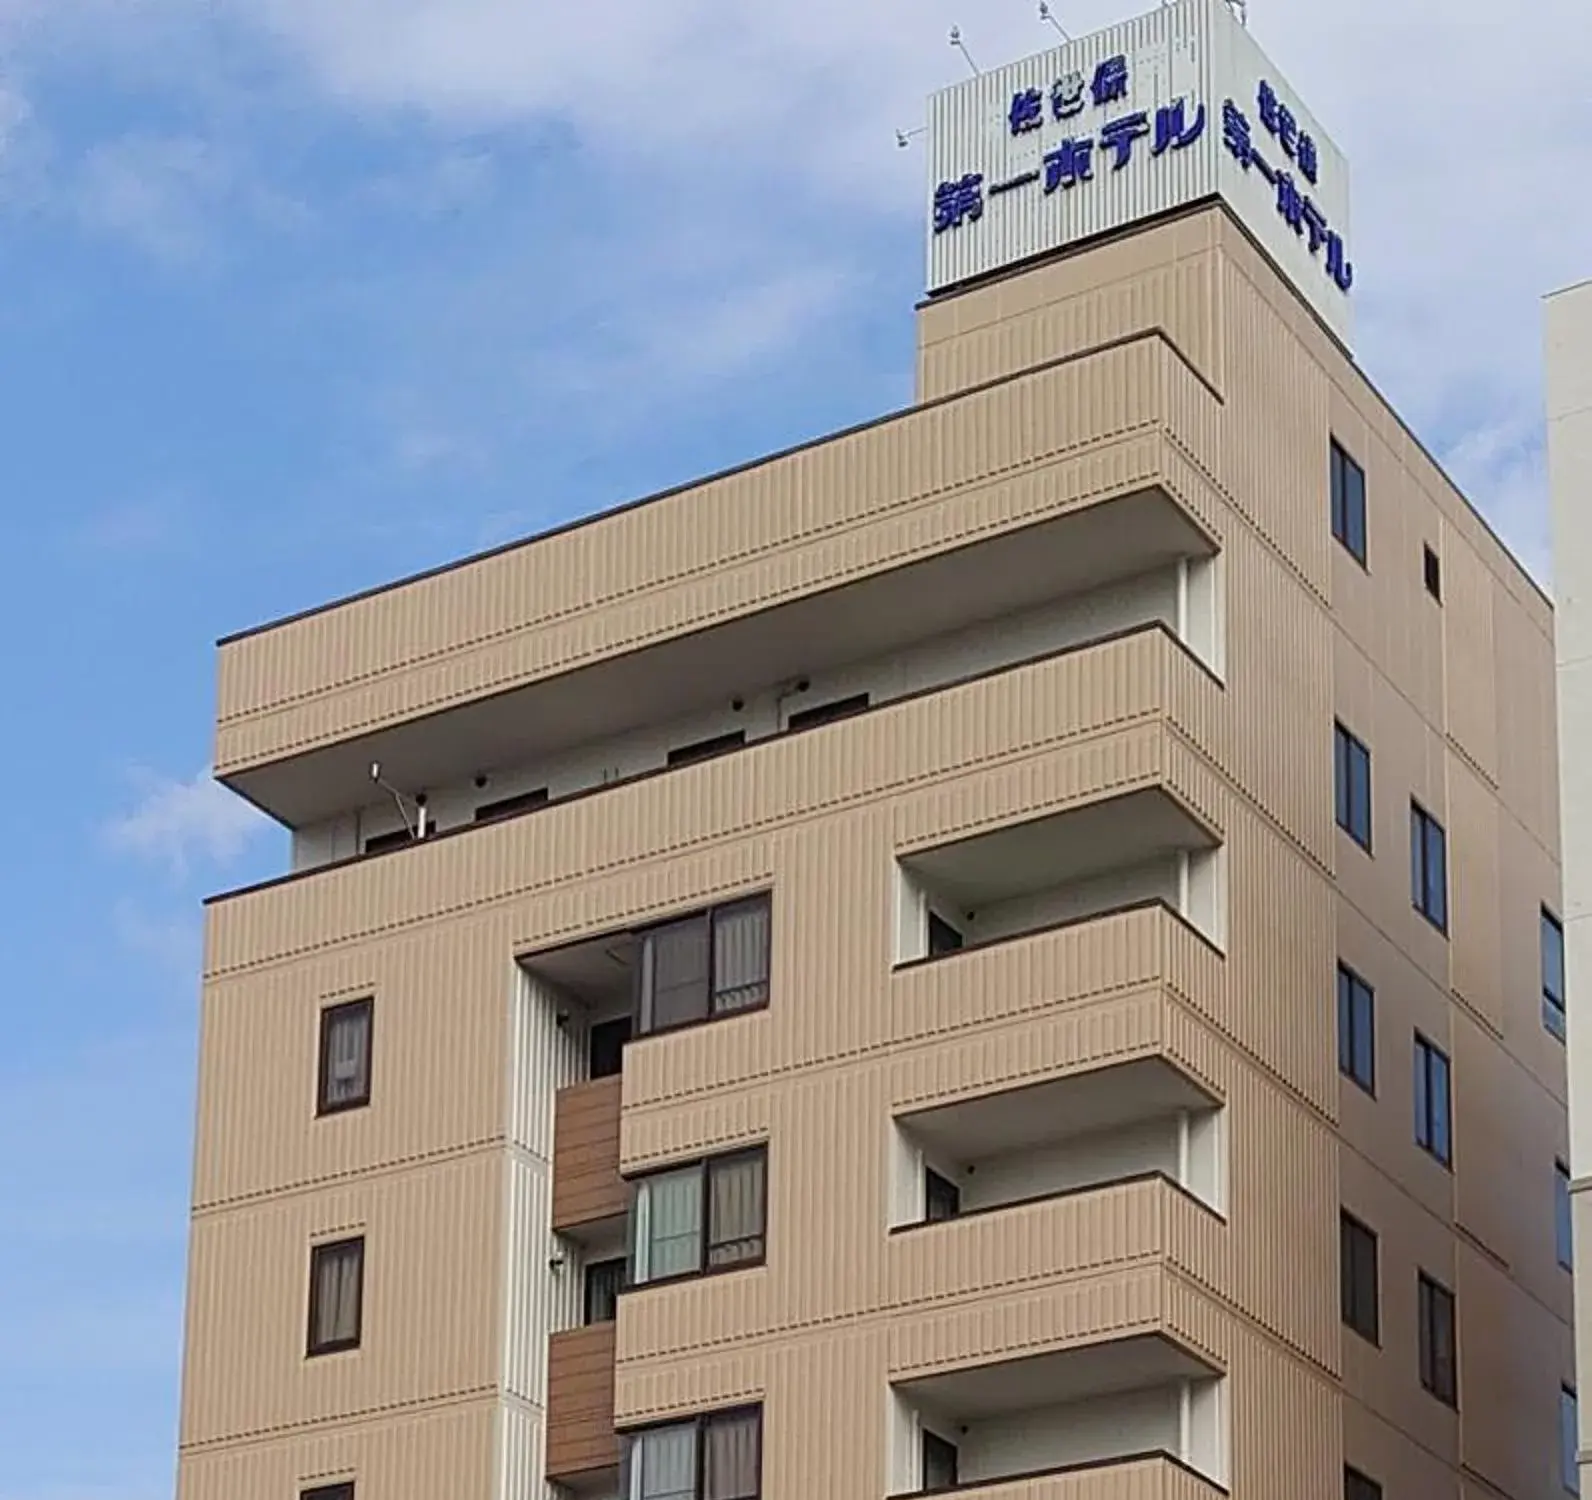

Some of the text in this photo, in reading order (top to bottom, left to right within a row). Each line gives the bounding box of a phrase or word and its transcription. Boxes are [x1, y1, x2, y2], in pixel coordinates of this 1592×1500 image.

[1008, 54, 1129, 136] 佐世保
[933, 95, 1205, 234] 第一ホテル
